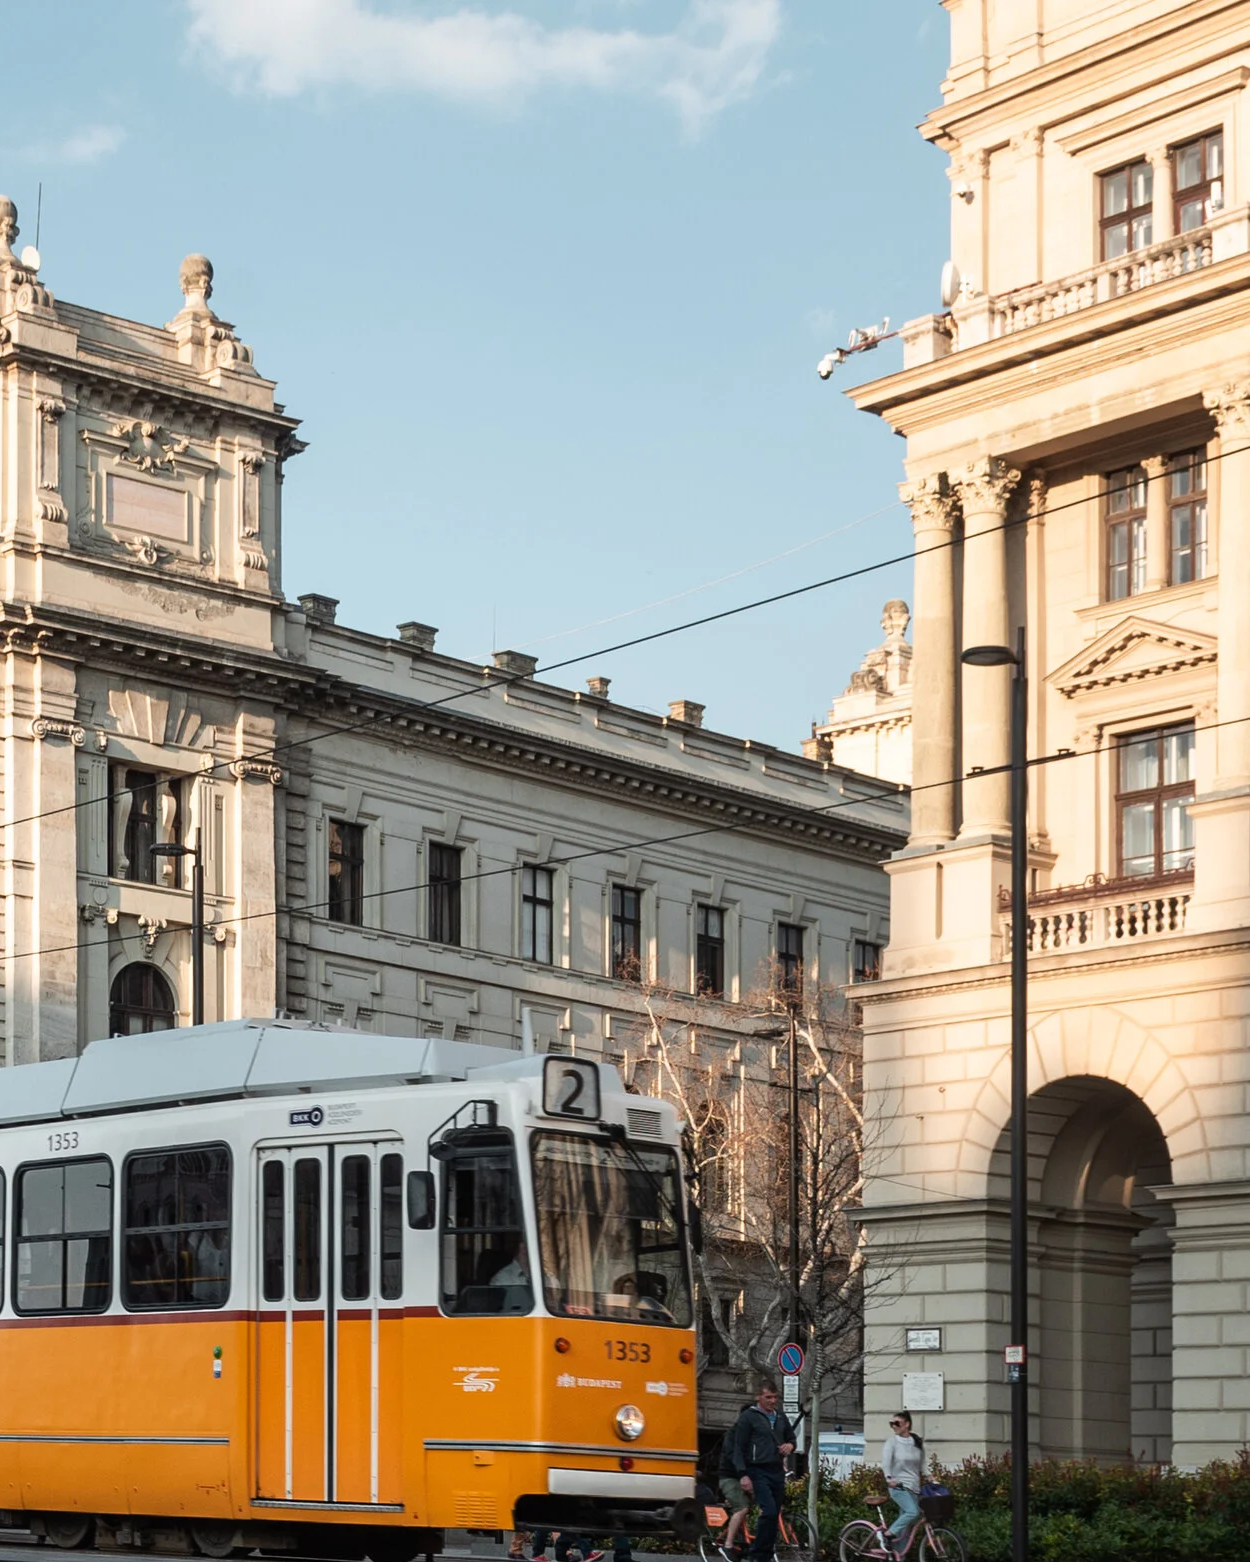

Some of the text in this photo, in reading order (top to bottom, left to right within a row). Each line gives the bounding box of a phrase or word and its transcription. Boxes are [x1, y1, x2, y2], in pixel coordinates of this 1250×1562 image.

[561, 1069, 585, 1115] 2
[47, 1131, 79, 1152] 1353
[605, 1340, 651, 1363] 1353
[577, 1377, 622, 1389] BUDAPEST
